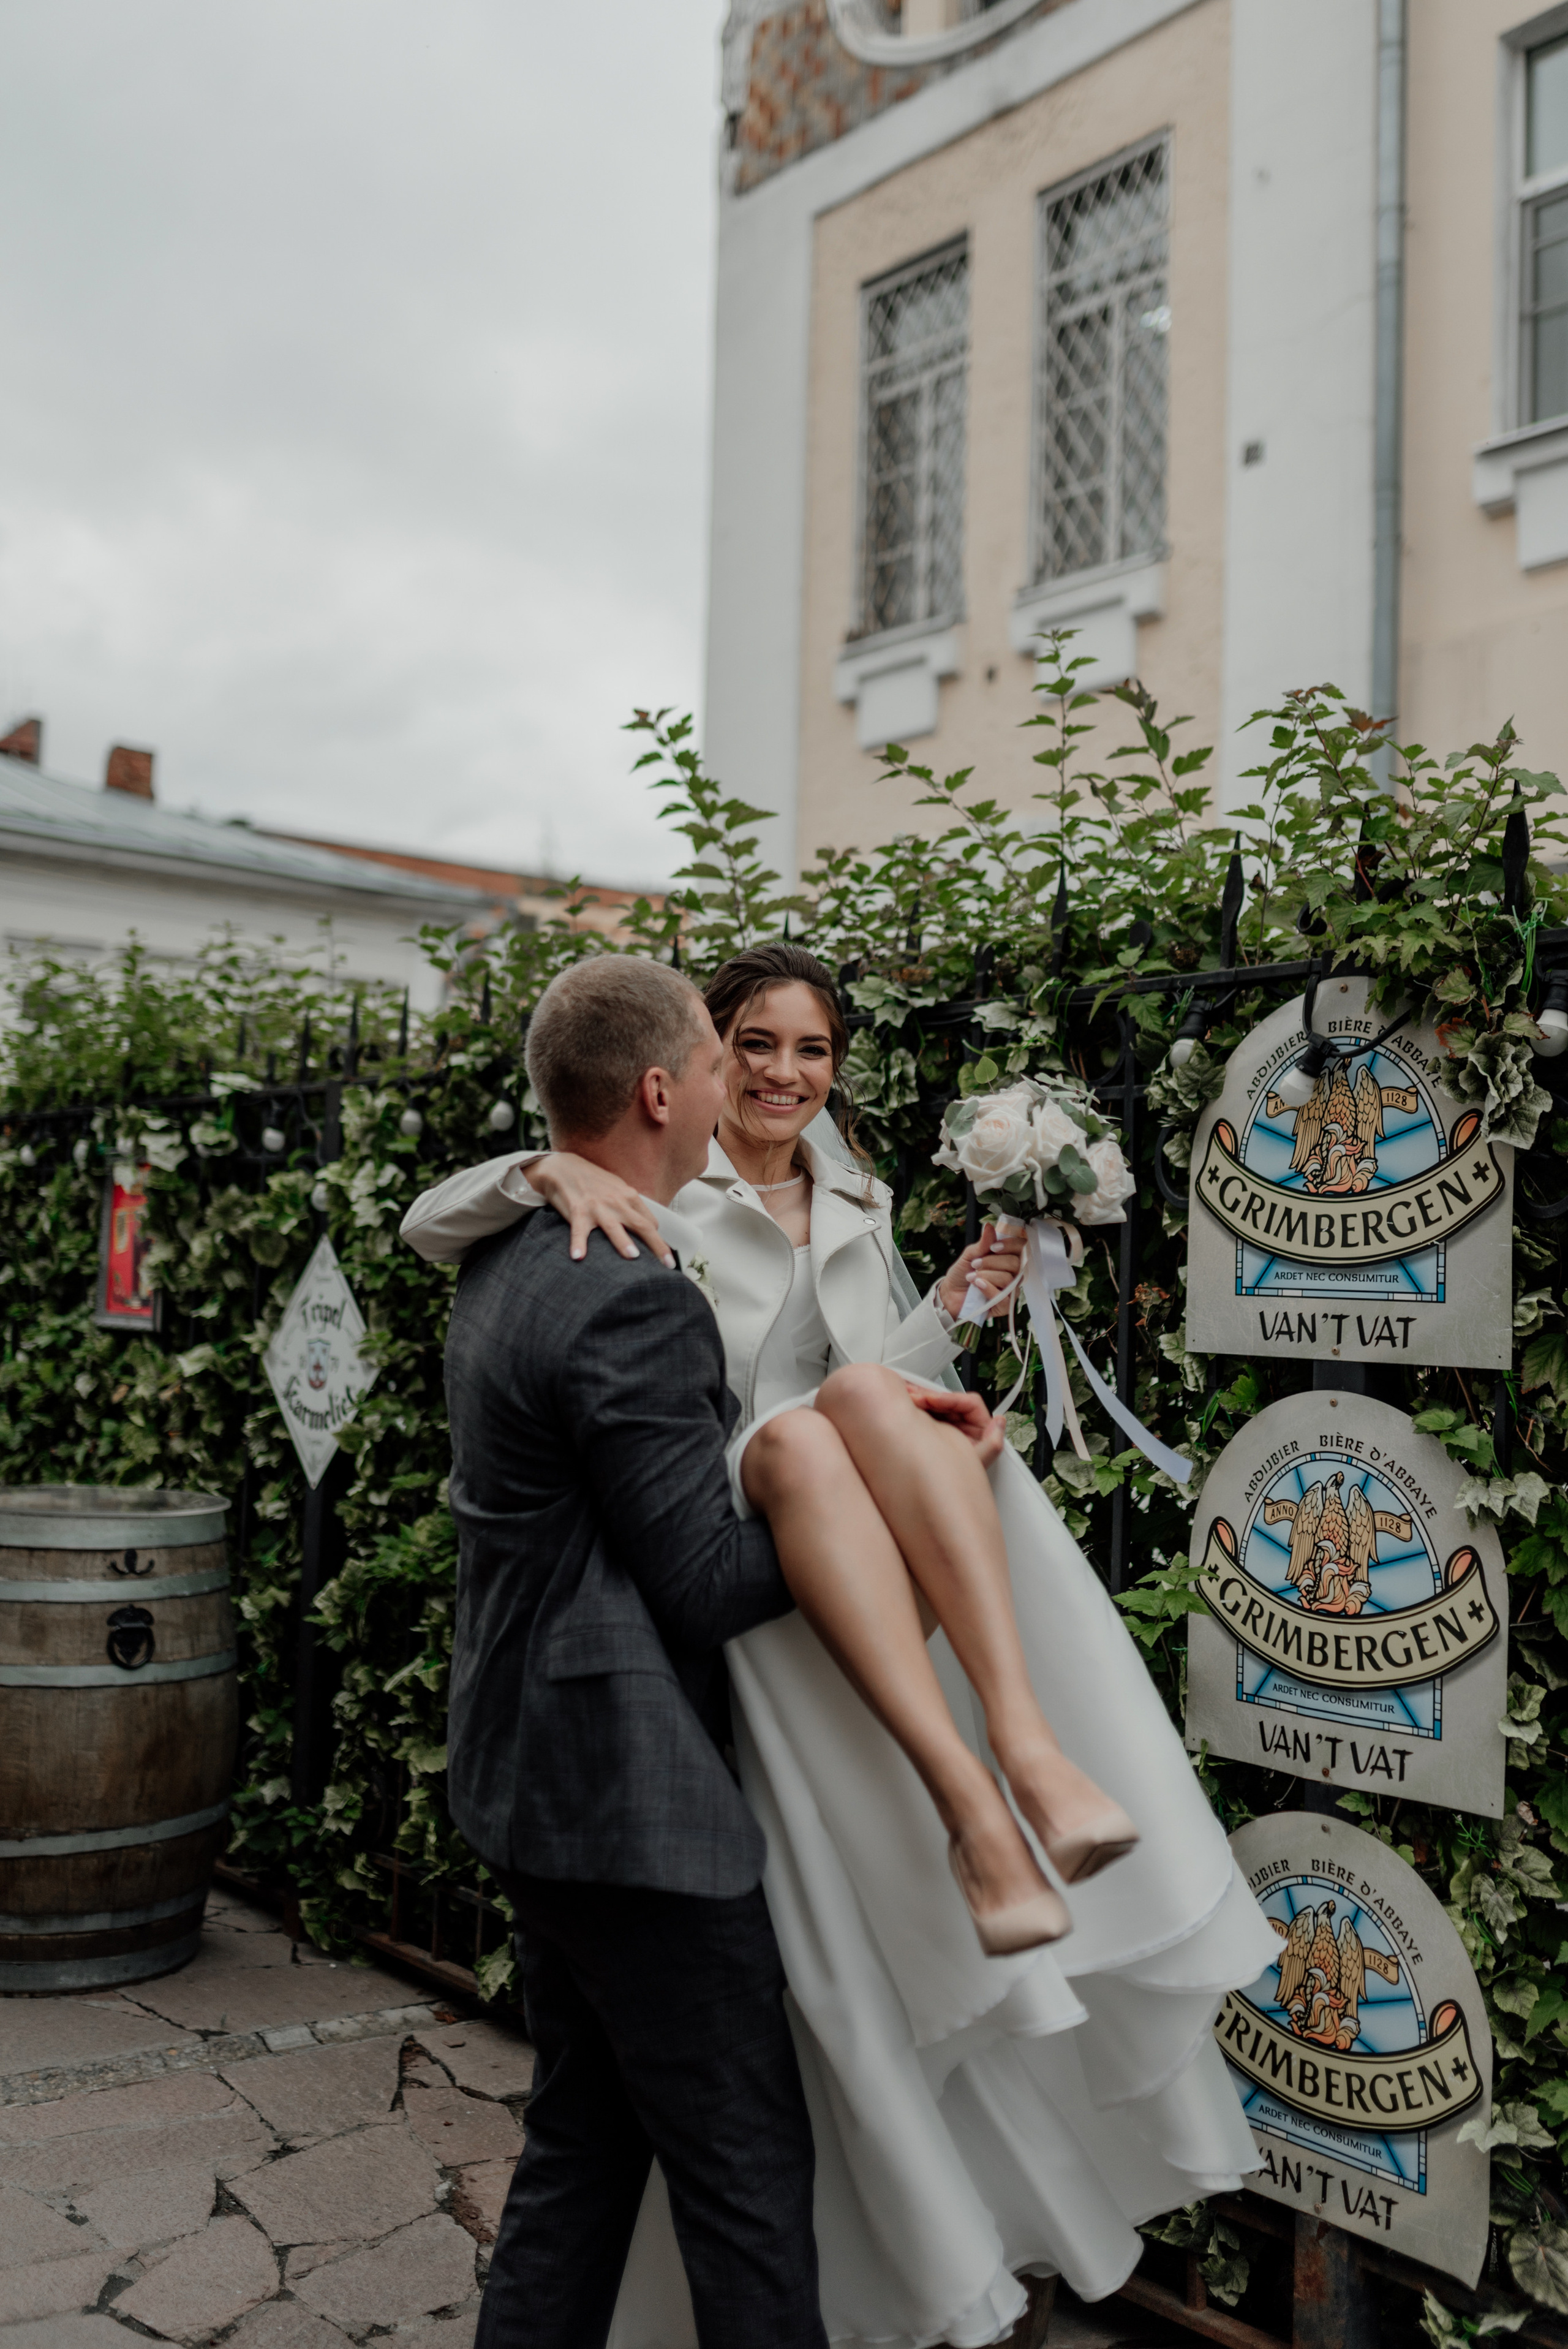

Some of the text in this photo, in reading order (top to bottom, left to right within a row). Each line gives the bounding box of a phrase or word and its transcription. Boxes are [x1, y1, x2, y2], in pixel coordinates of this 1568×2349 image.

[1328, 1016, 1372, 1034] BIÈRE
[1386, 1092, 1408, 1106] 1128
[1218, 1171, 1473, 1249] GRIMBERGEN
[1274, 1272, 1302, 1280] ARDET
[1328, 1273, 1399, 1284] CONSUMITUR
[1356, 1315, 1417, 1348] VAT
[1319, 1432, 1364, 1453] BIÈRE
[1270, 1505, 1401, 1533] ANNO 1128
[1219, 1578, 1469, 1671] GRIMBERGEN
[1273, 1683, 1395, 1714] ARDET NEC CONSUMITUR
[1351, 1741, 1413, 1782] VAT
[1311, 1859, 1355, 1885] BIÈRE
[1369, 1955, 1389, 1975] 1128
[1259, 2105, 1382, 2159] ARDET NEC CONSUMITUR
[1341, 2180, 1399, 2230] VAT
